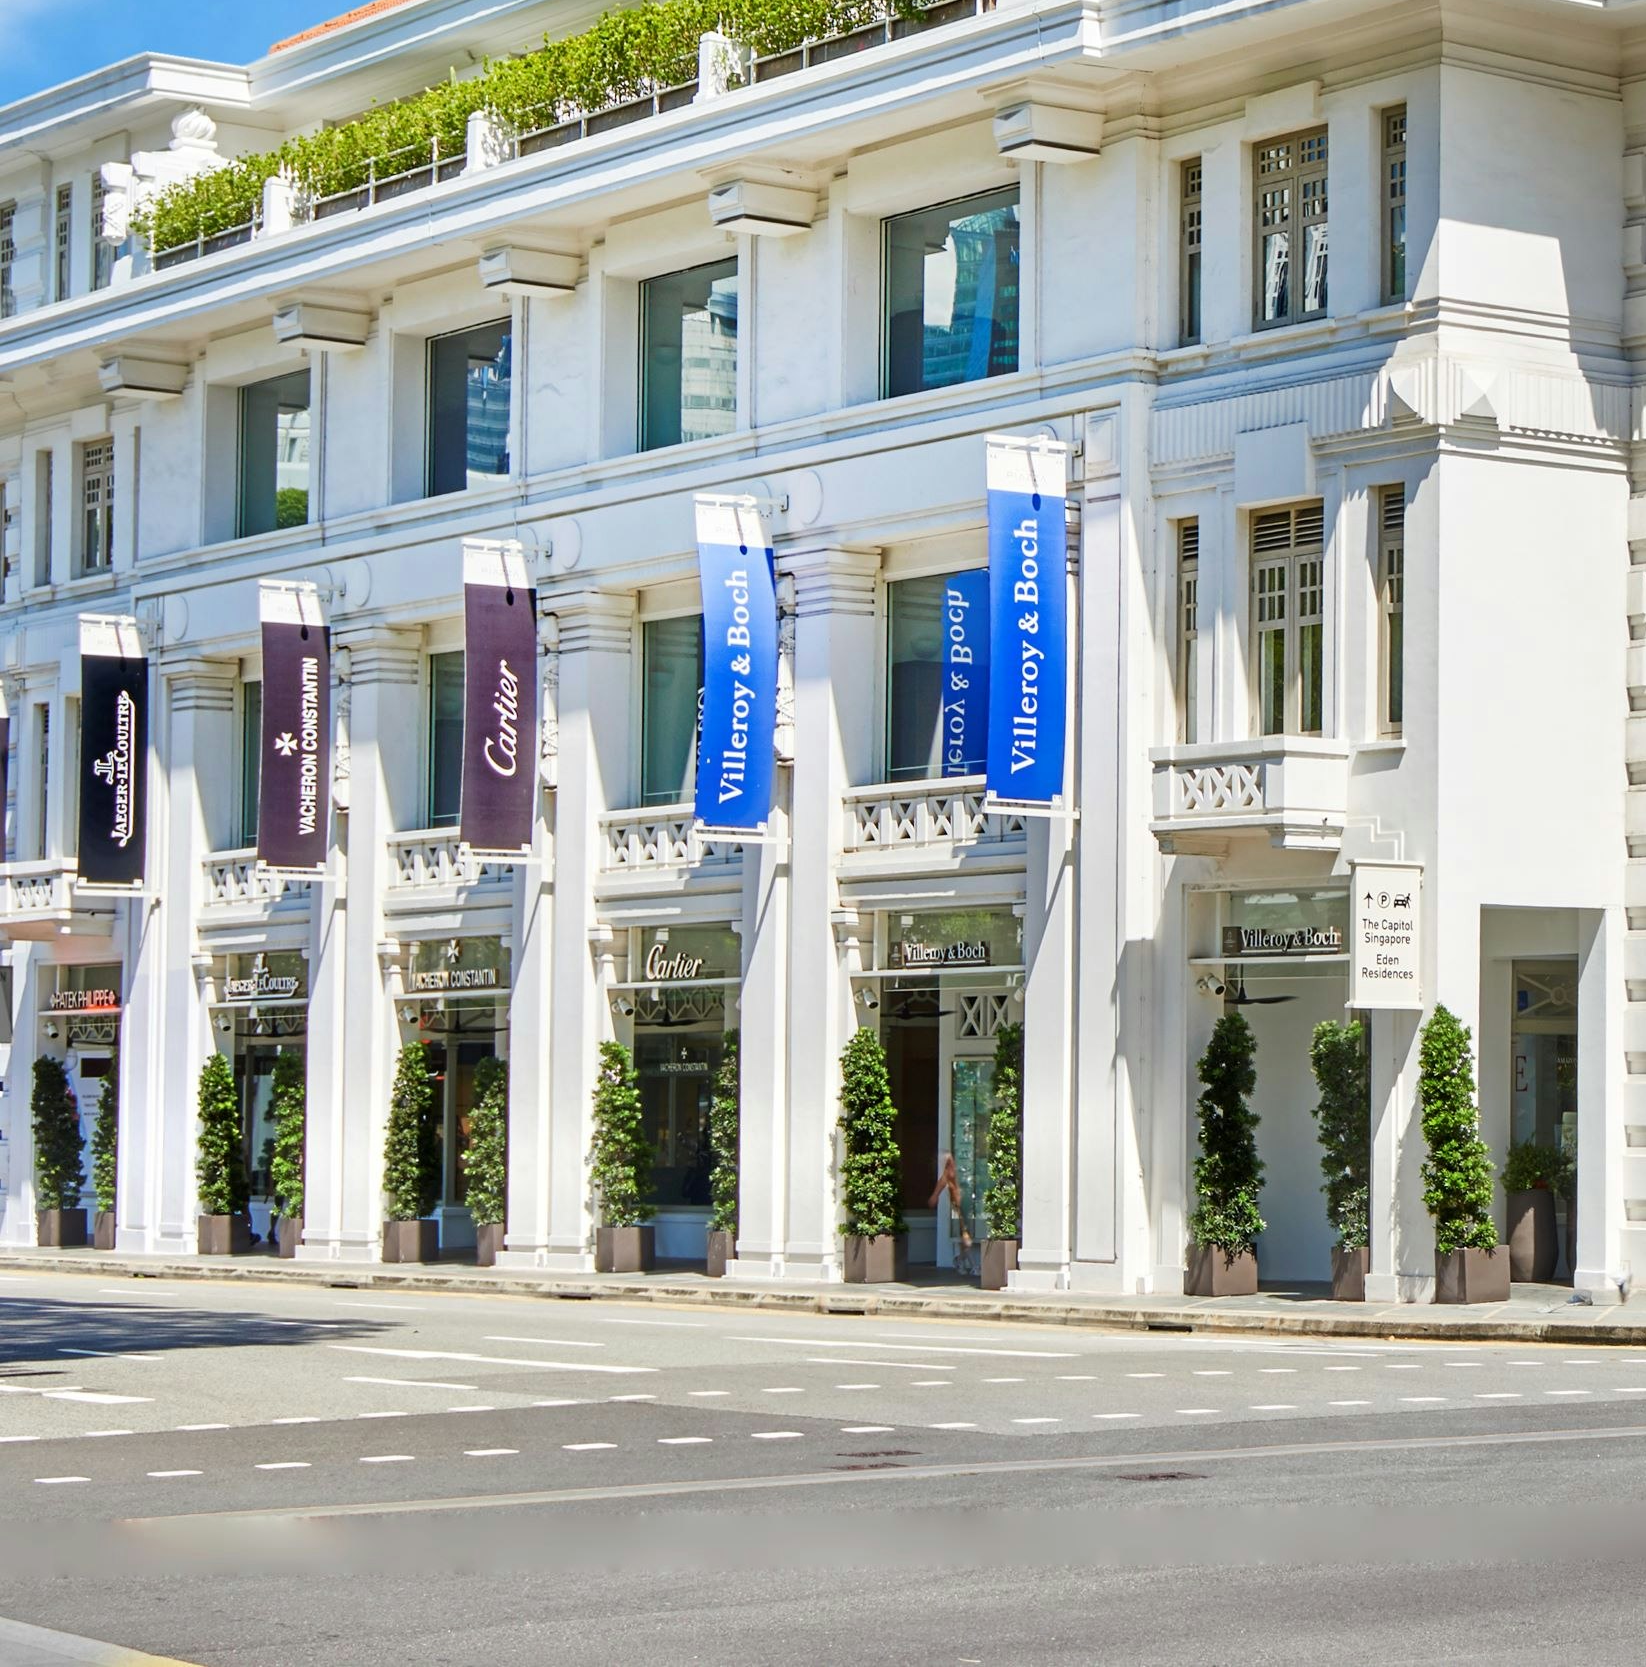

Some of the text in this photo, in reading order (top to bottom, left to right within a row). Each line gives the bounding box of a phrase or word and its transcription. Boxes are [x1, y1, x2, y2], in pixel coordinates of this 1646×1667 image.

[1011, 518, 1045, 775] Villeroy & Boch
[719, 569, 756, 805] Villeroy & Boch
[484, 659, 519, 777] Cartier
[299, 656, 319, 836] VACHERON CONSTANTIN
[1362, 918, 1413, 934] The Capitol
[1241, 926, 1339, 952] Villeroy & Boch
[1364, 932, 1411, 947] Singapore
[646, 944, 703, 981] Cartier
[904, 942, 947, 964] Villeroy
[957, 940, 986, 959] Boch
[1376, 954, 1400, 965] Eden
[450, 968, 496, 988] CONSTANTIN
[1361, 967, 1414, 980] Residences
[55, 988, 110, 1009] PATEK PHILIPPE
